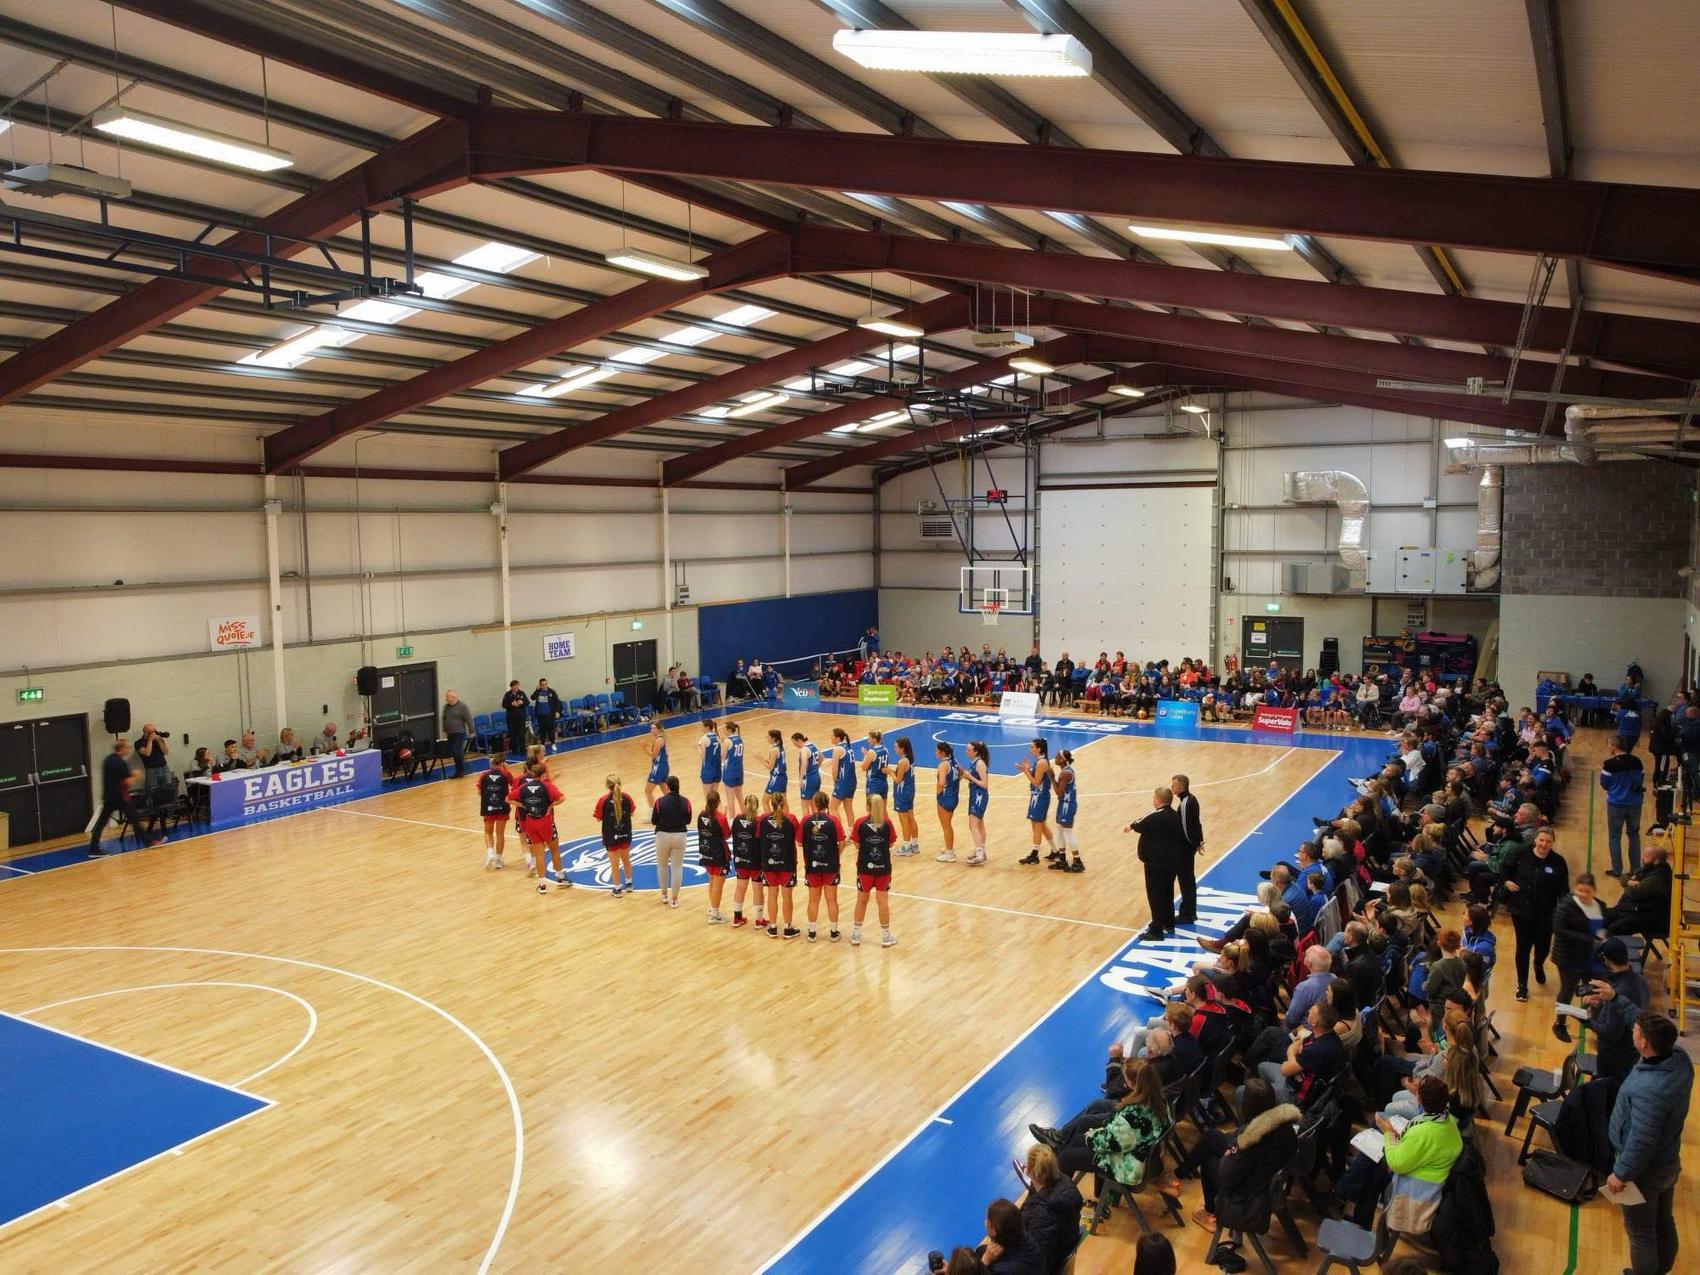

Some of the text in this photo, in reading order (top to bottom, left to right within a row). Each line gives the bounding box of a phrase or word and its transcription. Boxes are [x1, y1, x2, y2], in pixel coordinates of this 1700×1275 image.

[548, 640, 571, 651] HOME
[549, 648, 571, 658] TEAM
[937, 712, 1130, 732] EAGLES
[1257, 714, 1293, 727] SuperValu
[712, 742, 719, 756] 7
[733, 743, 743, 757] 10
[811, 751, 820, 766] 12
[878, 754, 888, 769] 14
[244, 758, 356, 801] EAGLES
[243, 784, 355, 816] BASKETBALL
